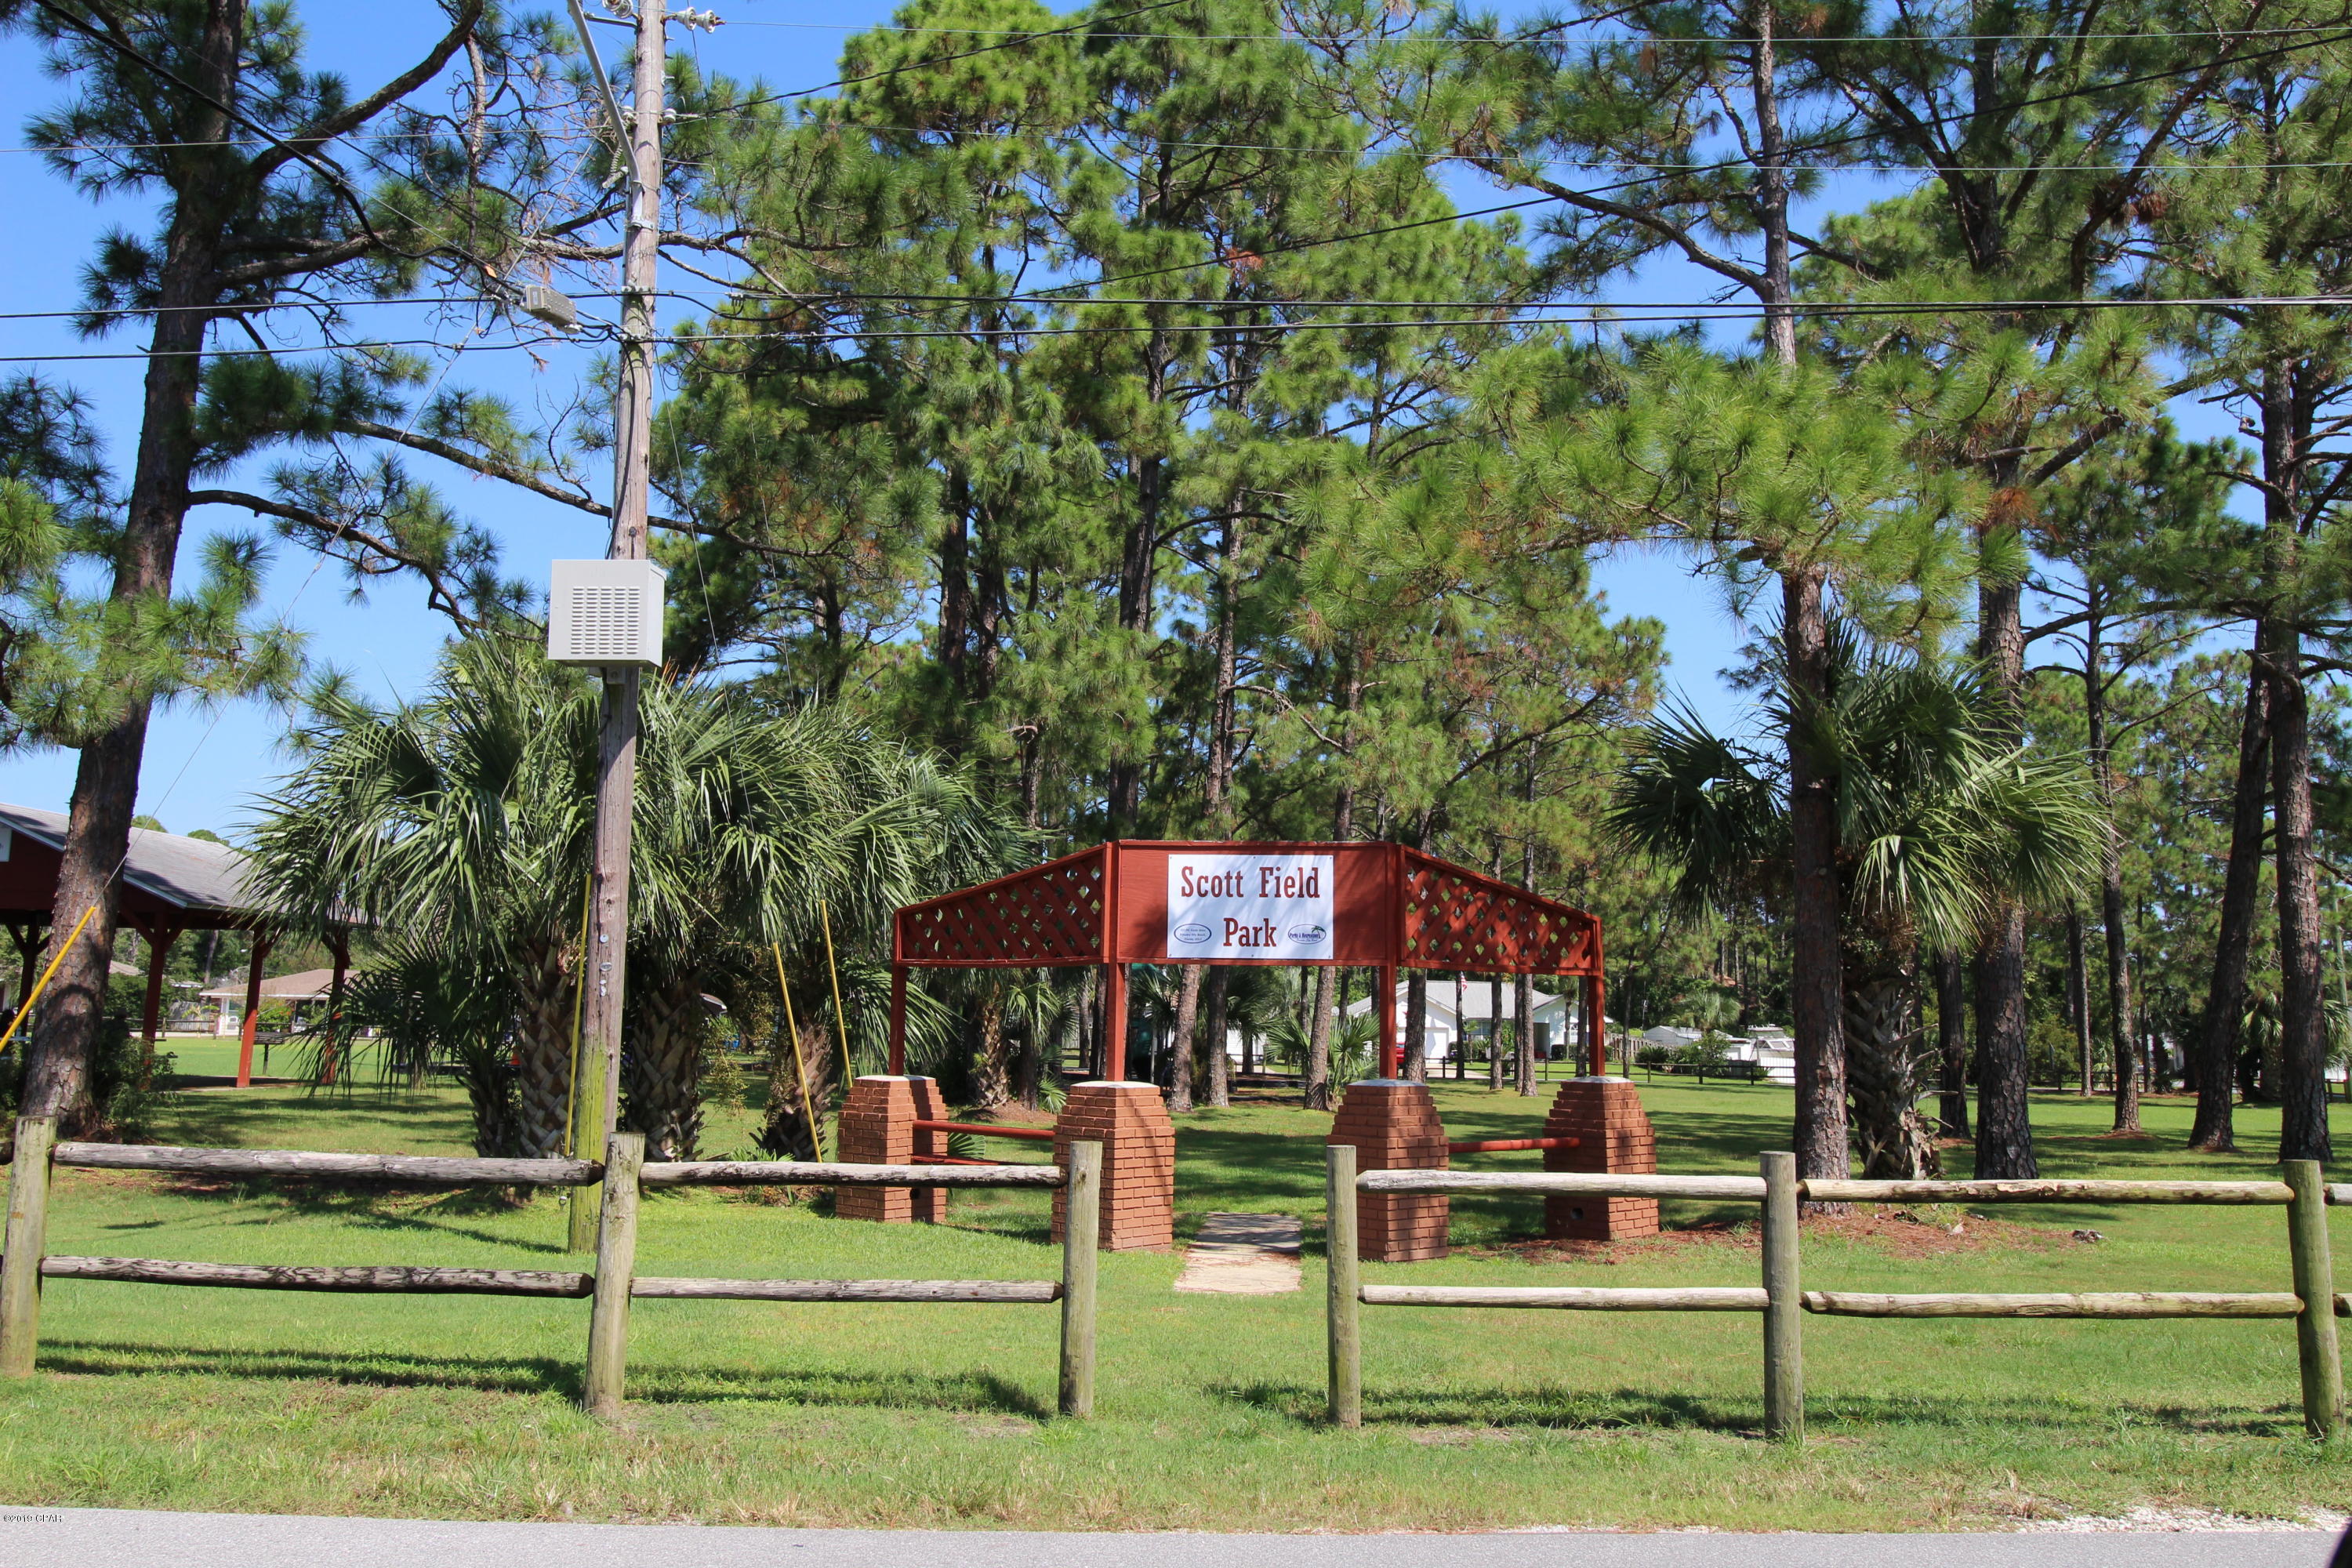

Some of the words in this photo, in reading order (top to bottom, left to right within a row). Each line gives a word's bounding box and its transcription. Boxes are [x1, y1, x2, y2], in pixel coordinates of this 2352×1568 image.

[1181, 866, 1244, 898] Scott
[1259, 866, 1320, 898] Field
[1223, 917, 1277, 947] Park
